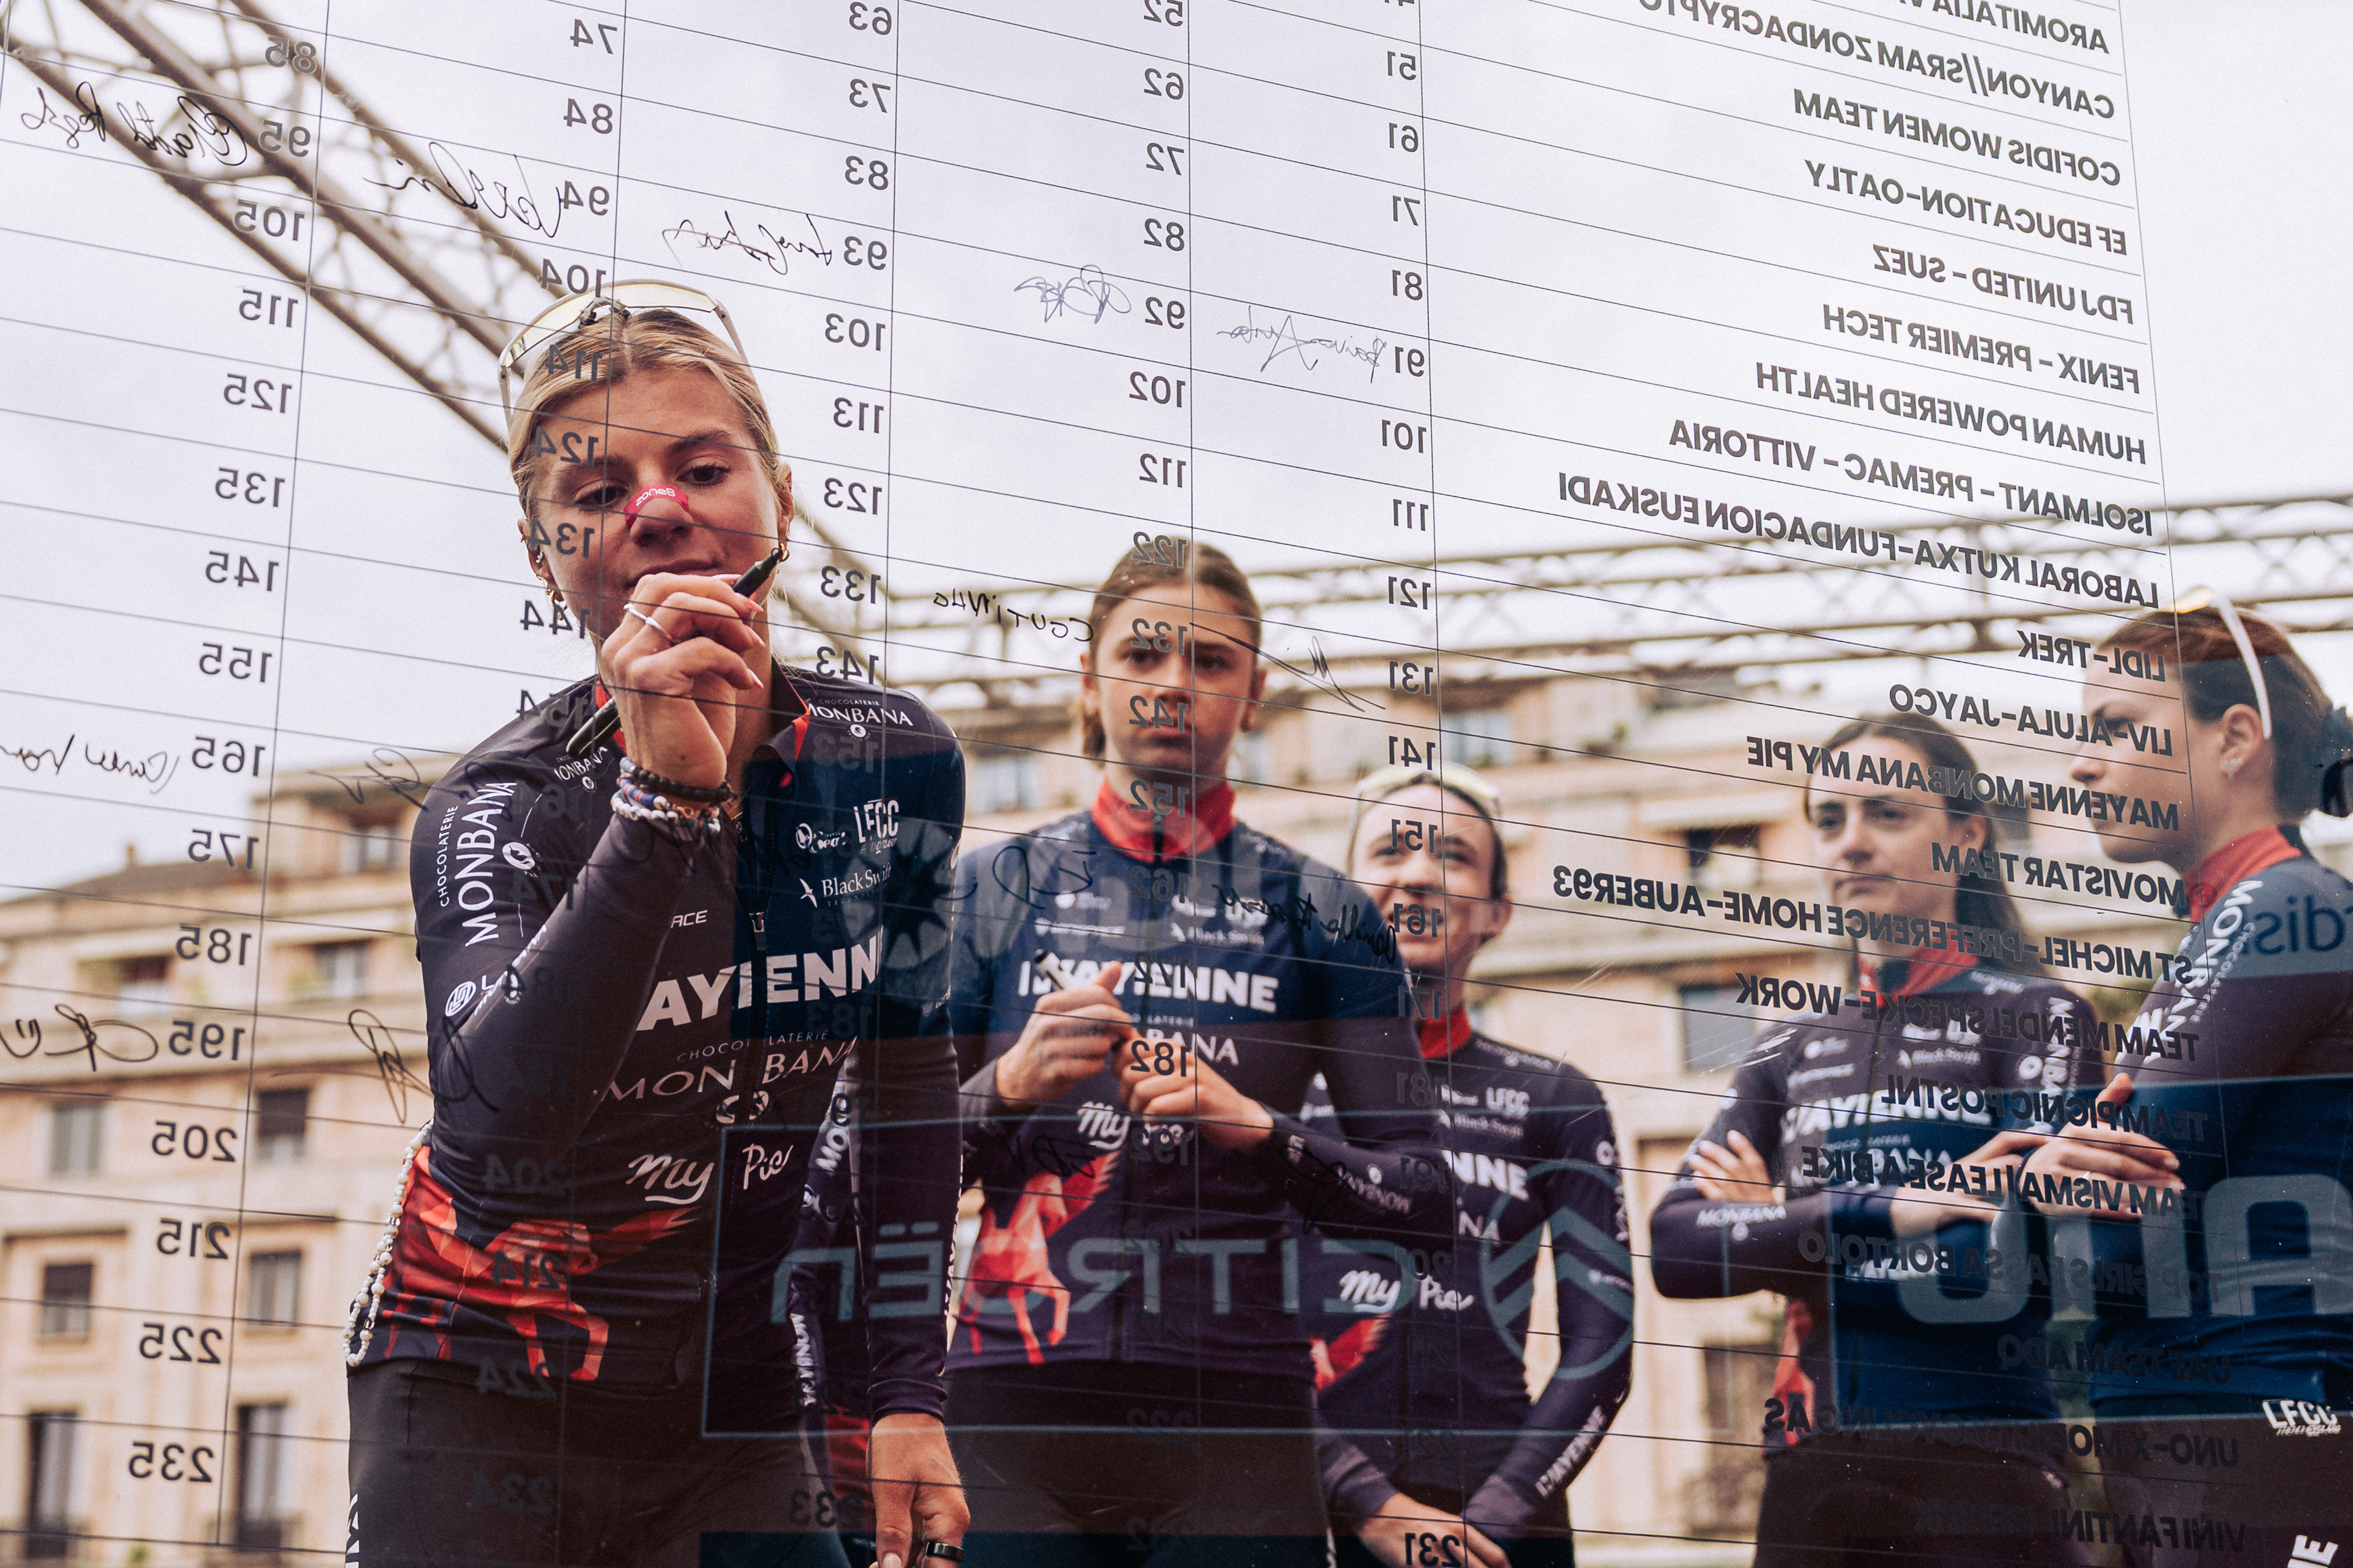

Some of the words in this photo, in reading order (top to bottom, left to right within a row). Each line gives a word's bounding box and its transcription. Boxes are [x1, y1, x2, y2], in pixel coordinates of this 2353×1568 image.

[635, 487, 675, 507] zone8
[854, 800, 899, 843] LFCC
[437, 806, 459, 907] CHOCOLATERIE
[455, 782, 517, 947] MONBANA
[821, 873, 863, 898] Black
[626, 1154, 715, 1205] My
[1341, 1271, 1401, 1312] My
